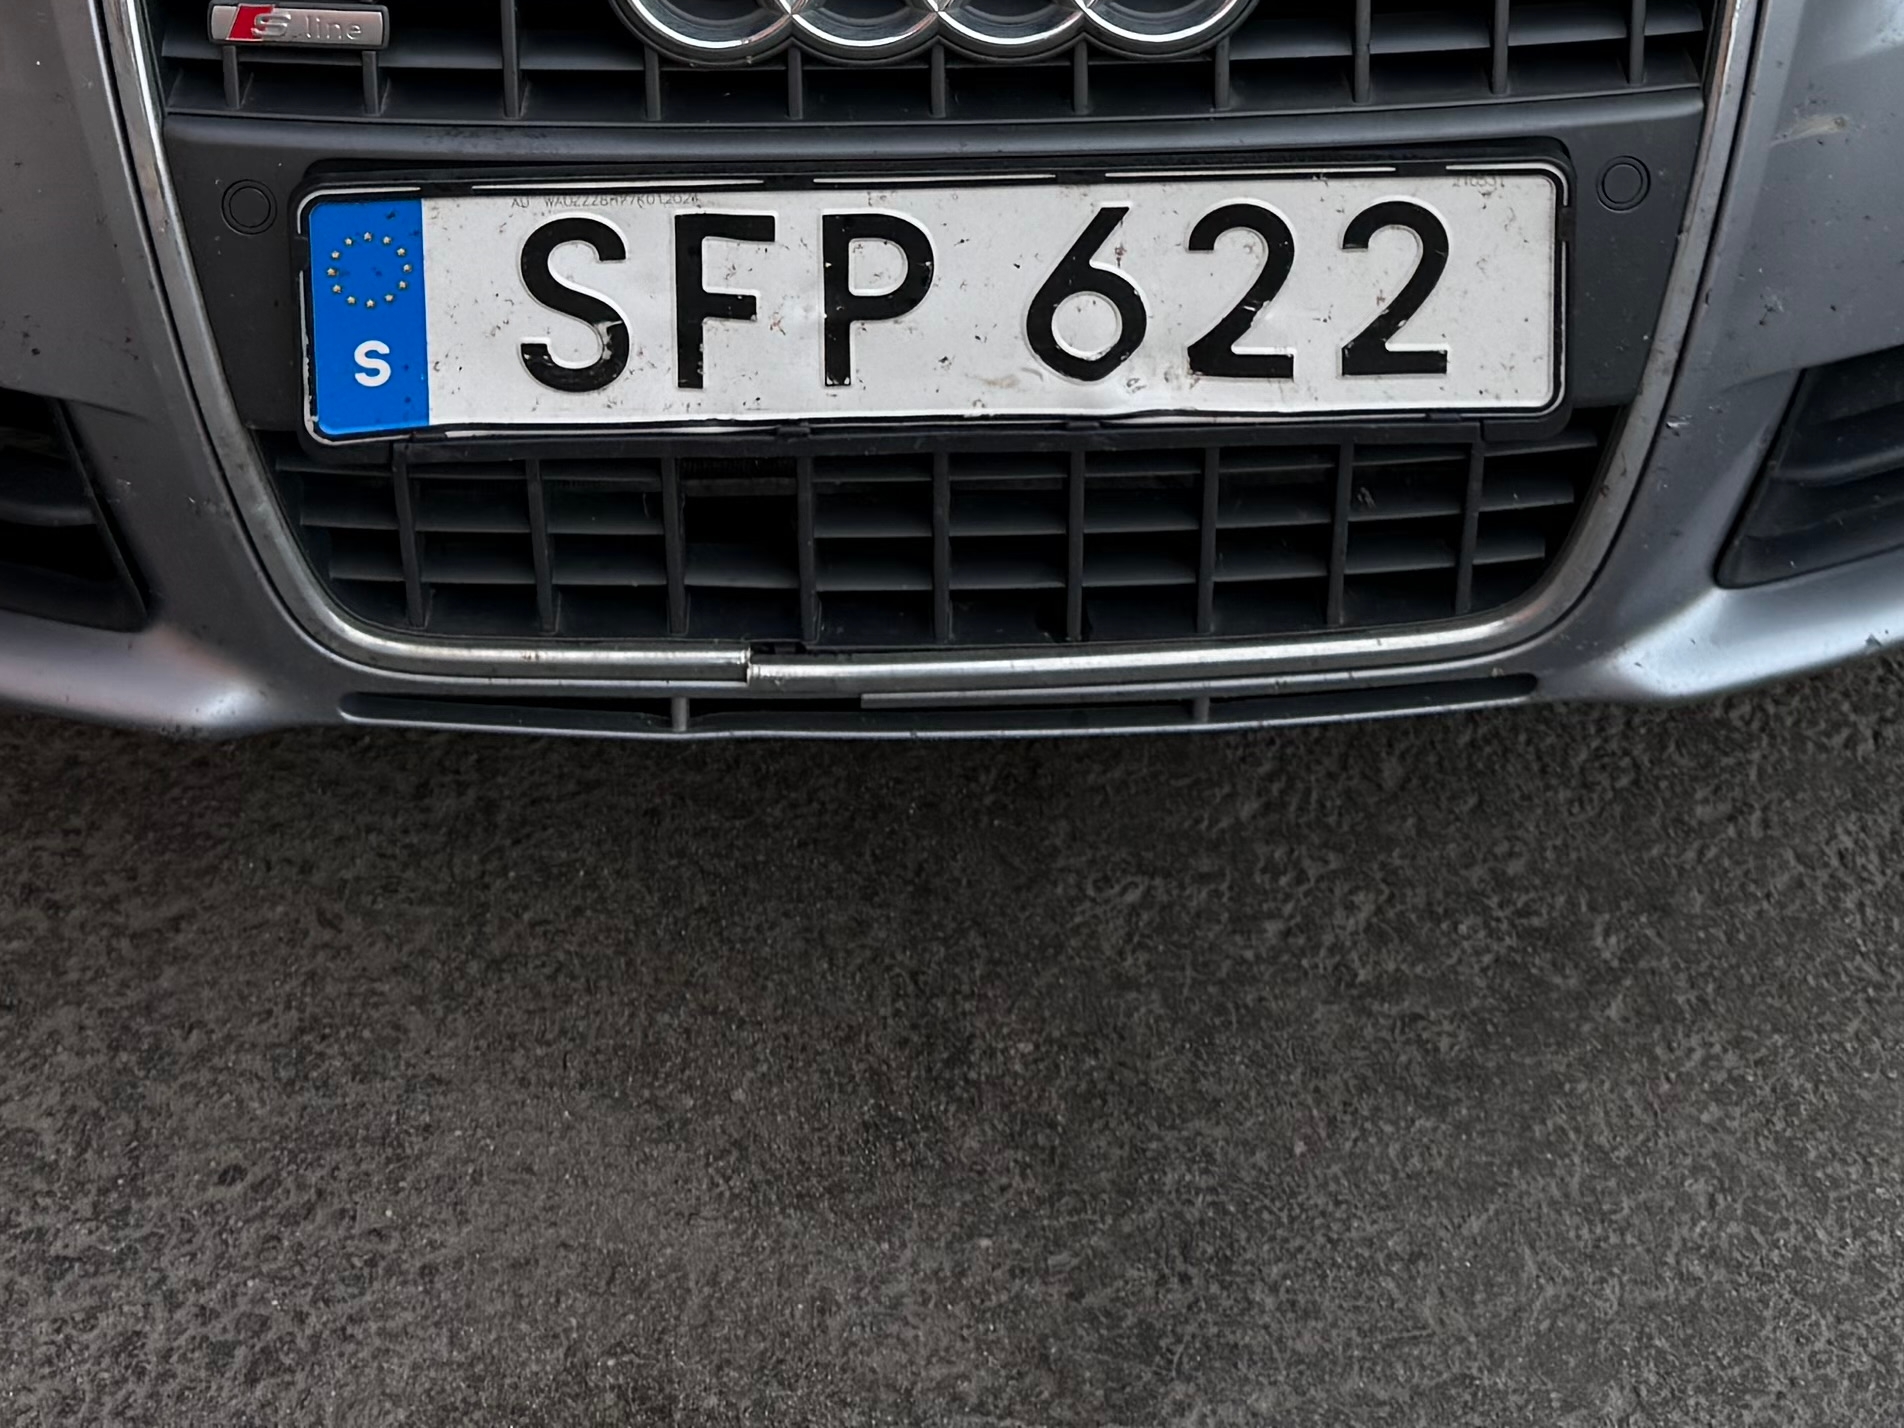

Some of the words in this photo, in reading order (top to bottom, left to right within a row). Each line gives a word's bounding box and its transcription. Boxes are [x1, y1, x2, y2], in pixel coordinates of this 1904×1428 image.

[304, 15, 363, 41] line
[520, 213, 935, 392] SFP
[1026, 201, 1450, 381] 622
[354, 340, 391, 387] S
